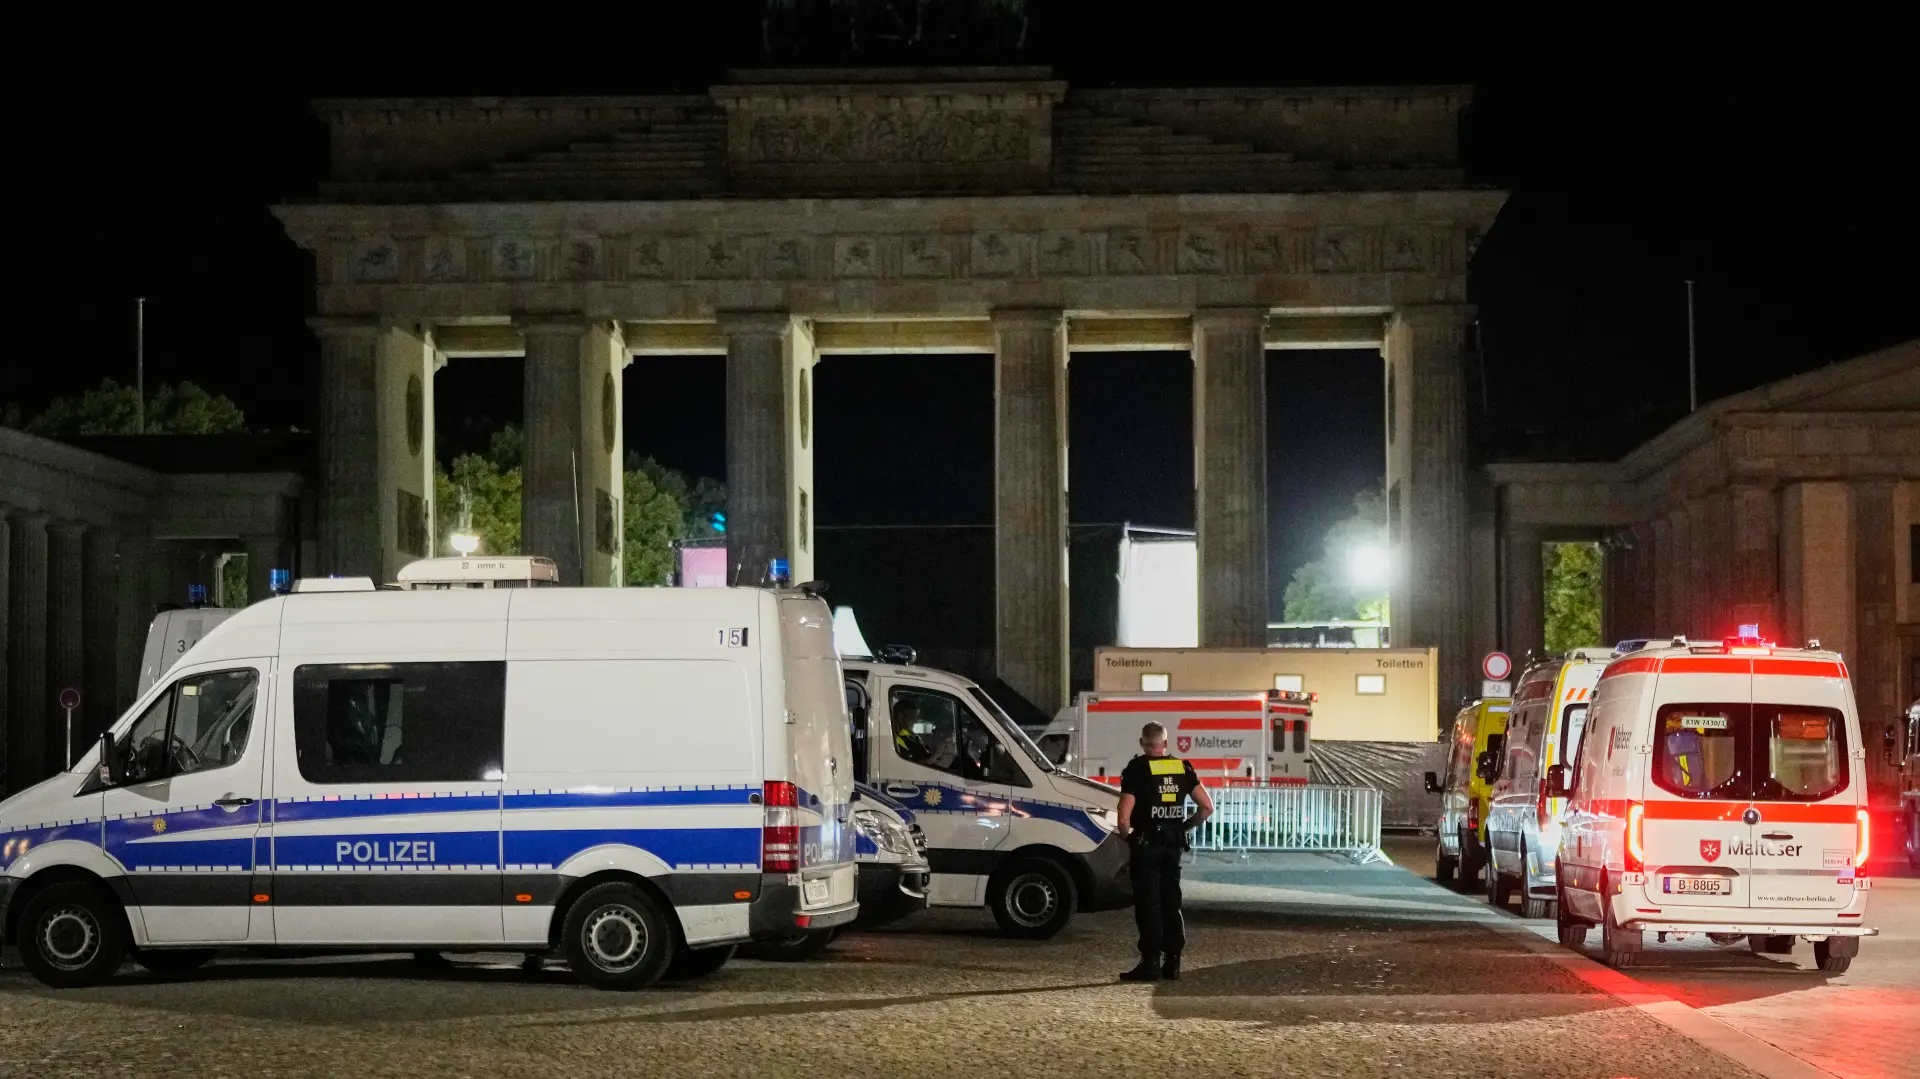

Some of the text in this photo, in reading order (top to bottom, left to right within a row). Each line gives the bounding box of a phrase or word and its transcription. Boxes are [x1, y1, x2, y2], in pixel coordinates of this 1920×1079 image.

[1105, 657, 1152, 667] Toiletten
[1376, 659, 1424, 669] Toiletten
[1195, 735, 1245, 748] Malteser
[1163, 777, 1174, 785] BE
[336, 841, 435, 862] POLIZEI
[1728, 839, 1803, 857] Malteser
[1678, 880, 1720, 891] B 8805
